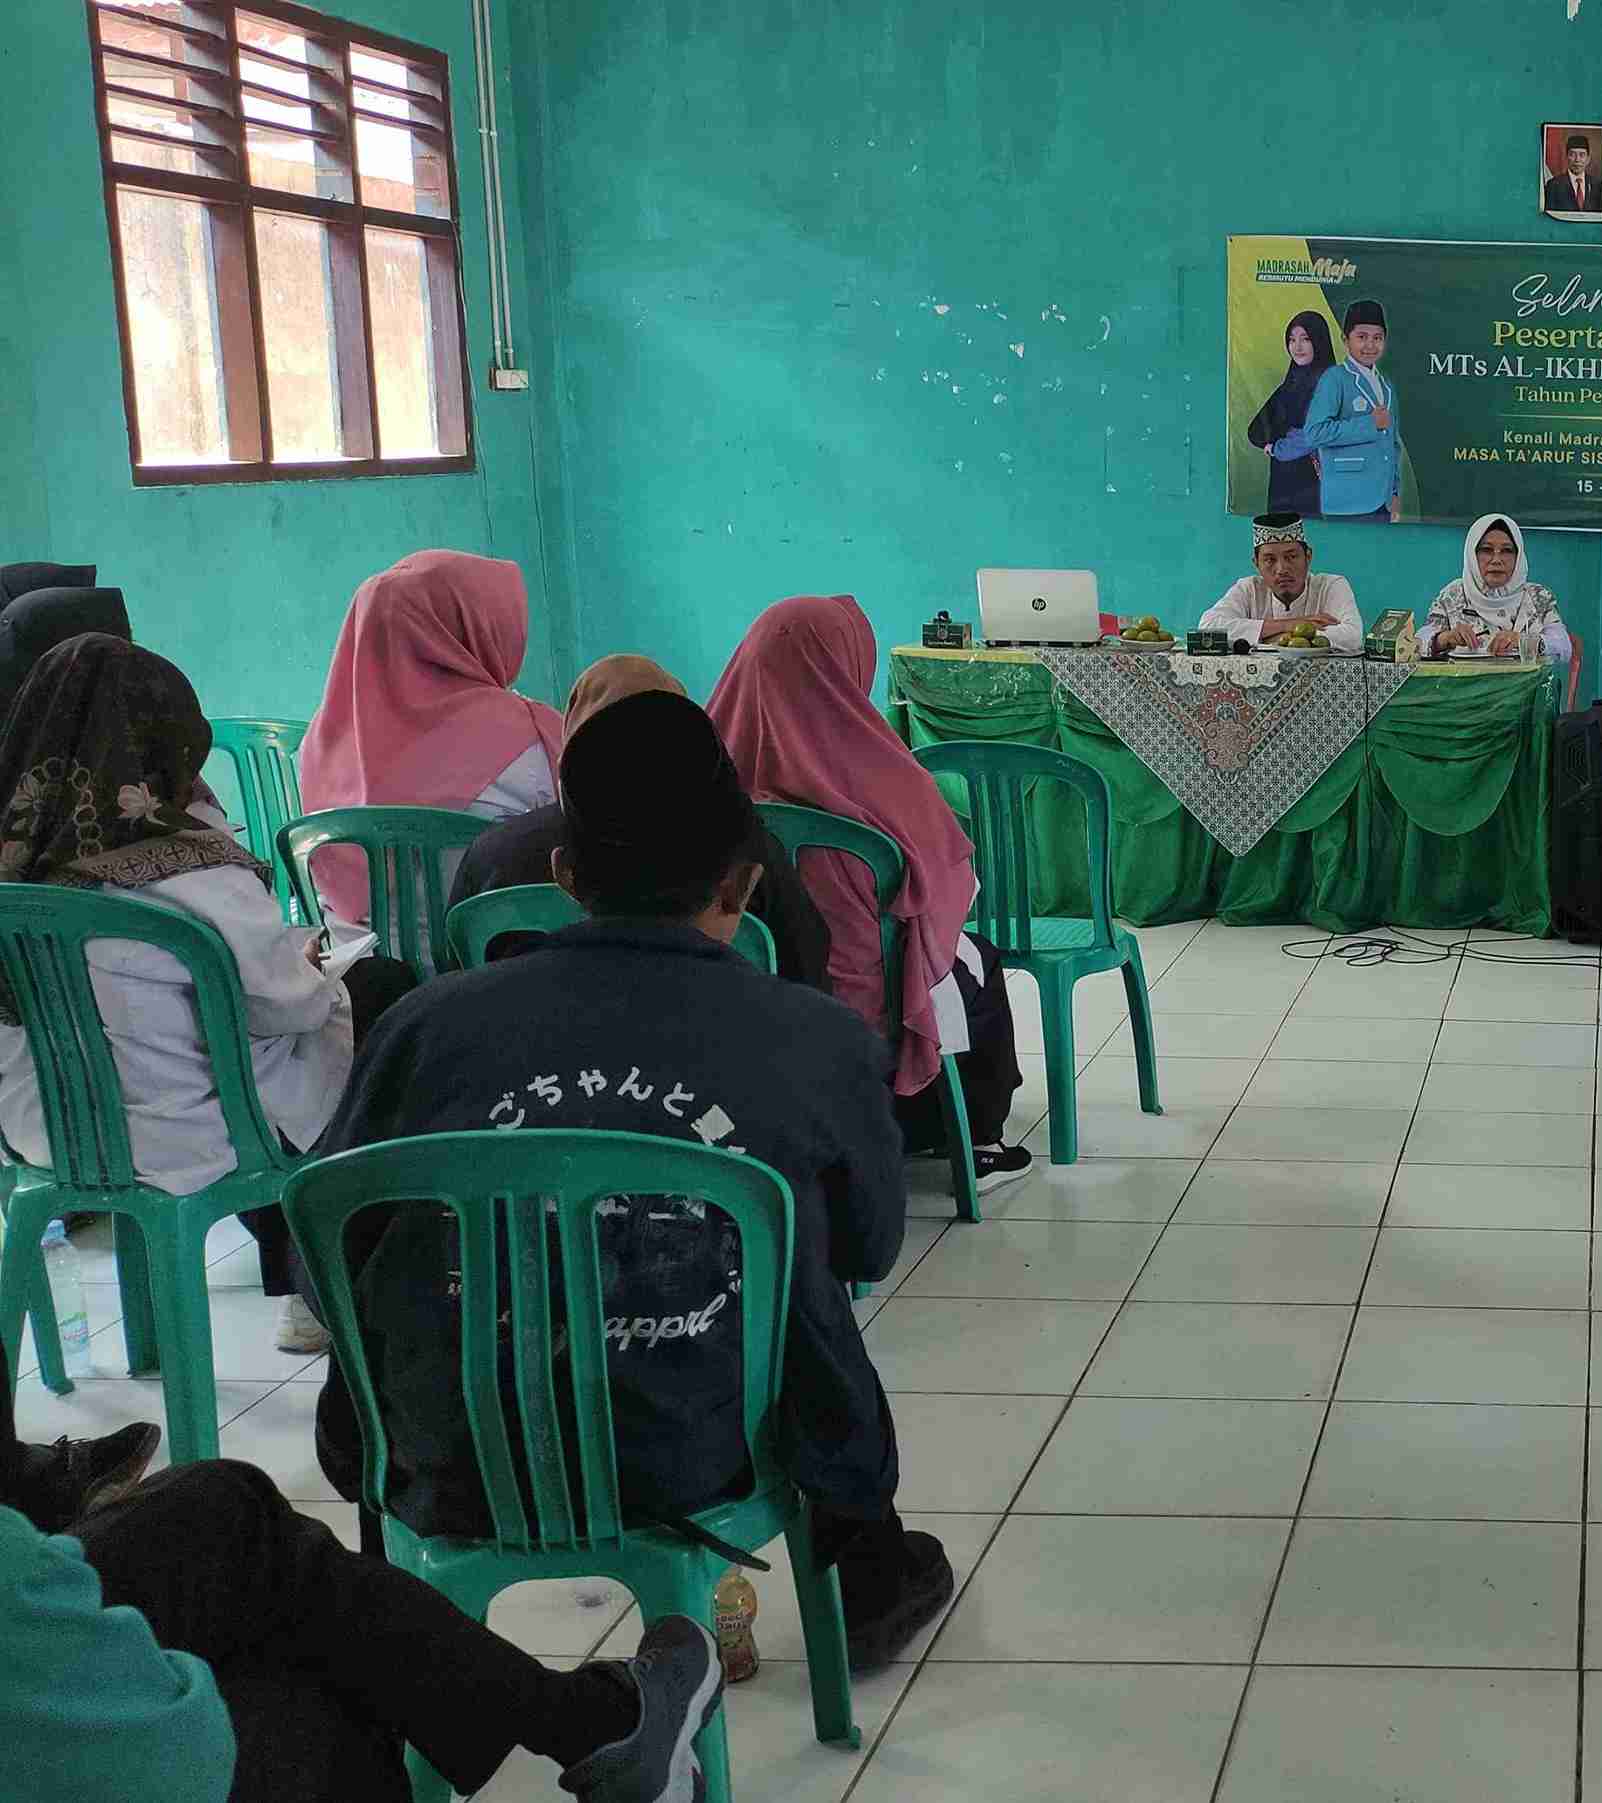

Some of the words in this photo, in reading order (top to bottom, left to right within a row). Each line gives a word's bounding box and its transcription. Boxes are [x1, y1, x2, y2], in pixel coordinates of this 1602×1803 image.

[1429, 353, 1488, 376] MTs
[1515, 386, 1576, 402] Tahun
[1503, 430, 1553, 445] Kenali
[1454, 447, 1500, 461] MASA
[1505, 449, 1576, 463] TA'ARUF
[1576, 479, 1593, 493] 15
[1033, 599, 1045, 611] hp
